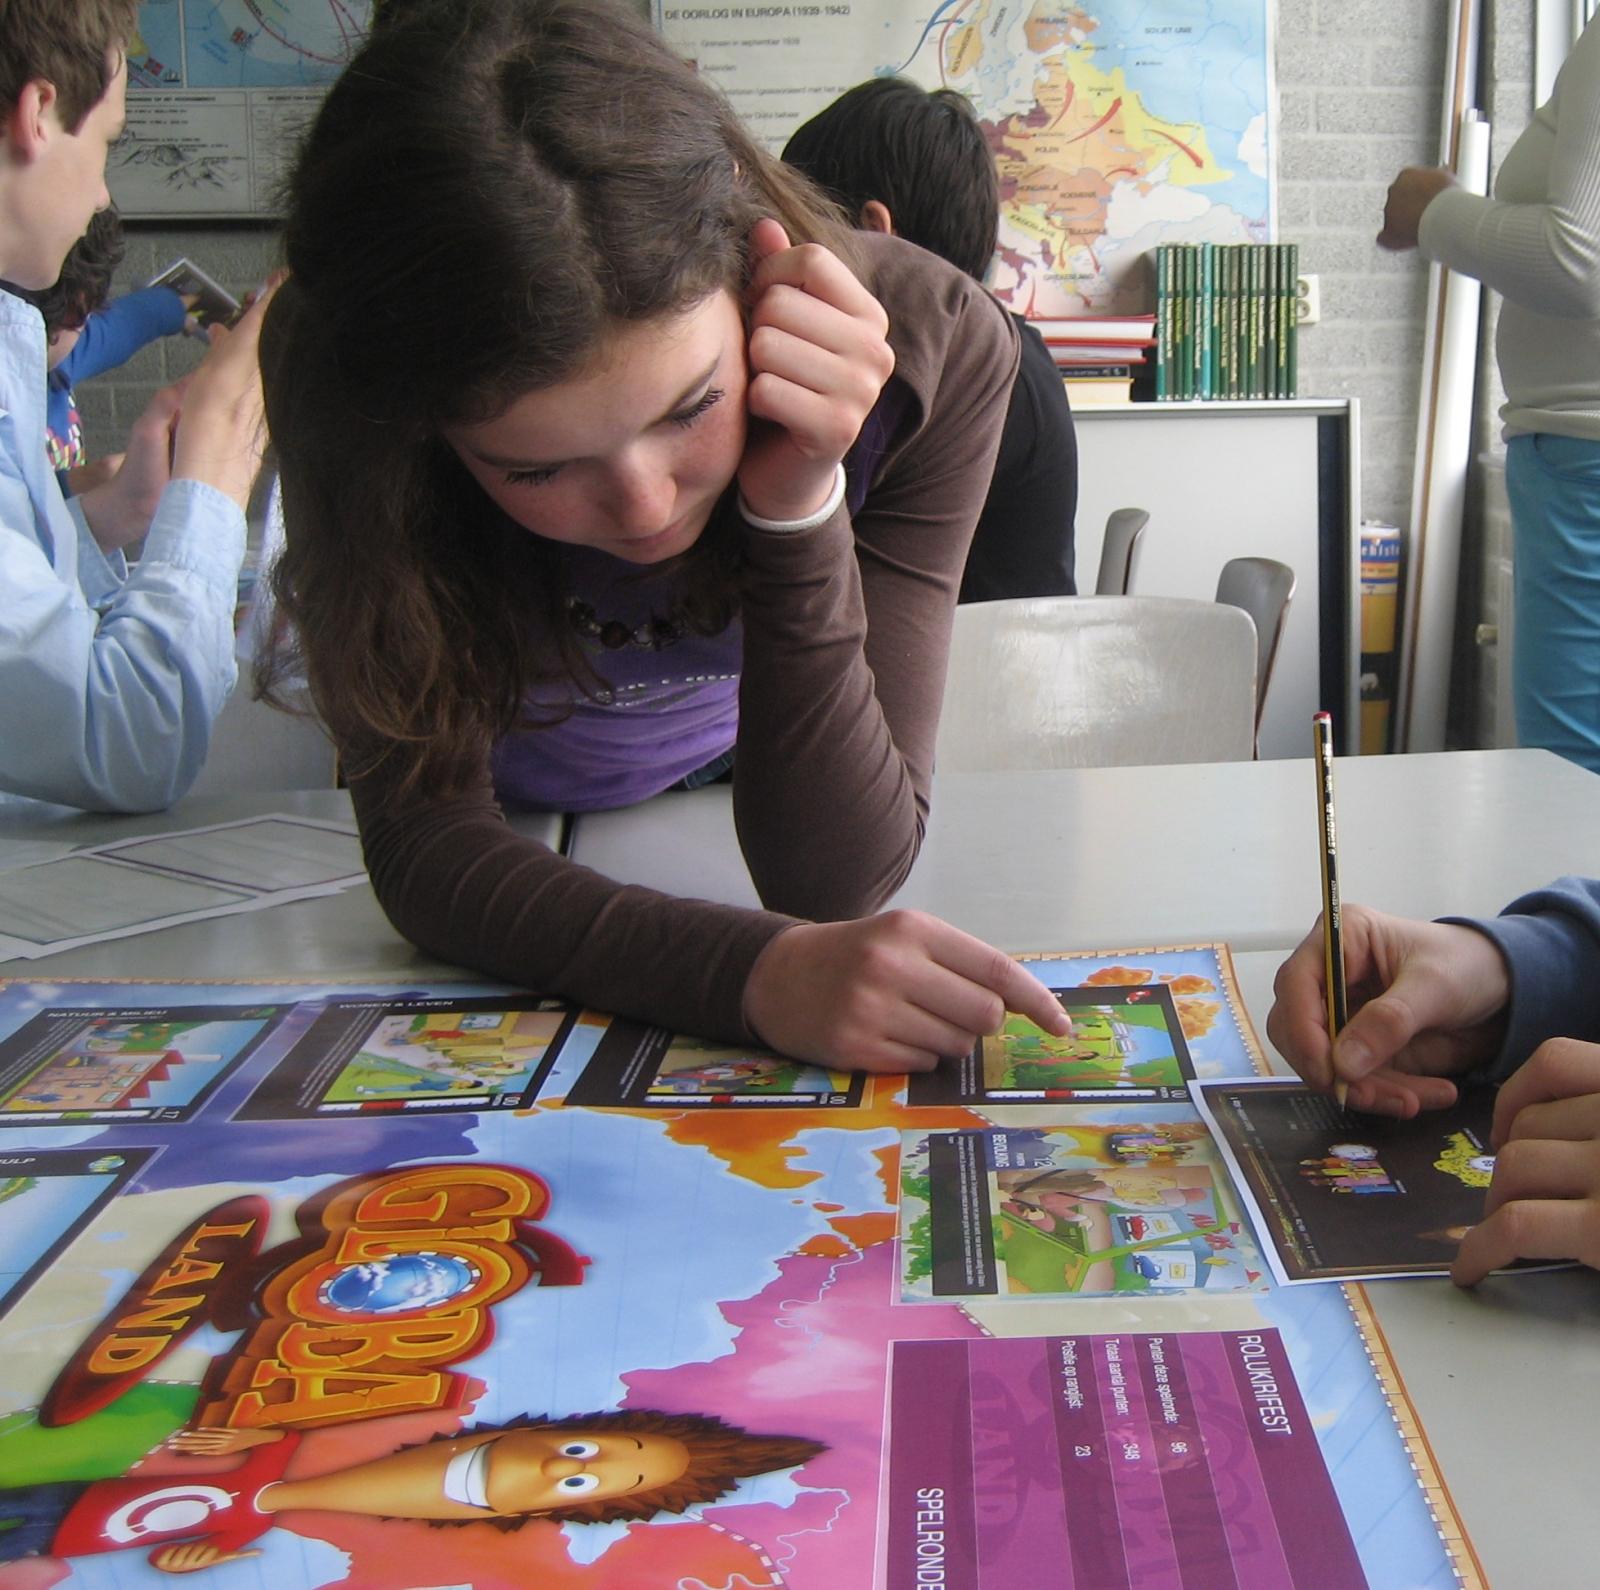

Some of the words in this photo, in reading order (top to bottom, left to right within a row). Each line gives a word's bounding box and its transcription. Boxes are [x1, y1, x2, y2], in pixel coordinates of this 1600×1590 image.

[664, 10, 681, 20] DE
[682, 8, 728, 19] OORLOG
[732, 8, 742, 18] IN
[746, 7, 792, 18] EUROPA
[48, 1010, 106, 1018] NATUUR
[992, 1134, 1010, 1168] BEVOLKING
[1034, 1157, 1052, 1167] 12
[86, 1217, 264, 1375] LAND
[1060, 1340, 1080, 1364] Positie
[1104, 1338, 1124, 1361] Totaal
[1148, 1338, 1169, 1362] Punten
[1062, 1366, 1078, 1376] op
[1108, 1363, 1128, 1385] aantal
[1154, 1364, 1171, 1382] deze
[1236, 1334, 1293, 1435] ROLUKIRIFEST
[1108, 1387, 1130, 1416] punten:
[1074, 1445, 1092, 1456] 23
[1122, 1443, 1139, 1460] 348
[1170, 1440, 1188, 1453] 96
[916, 1487, 945, 1590] SPELRONDE
